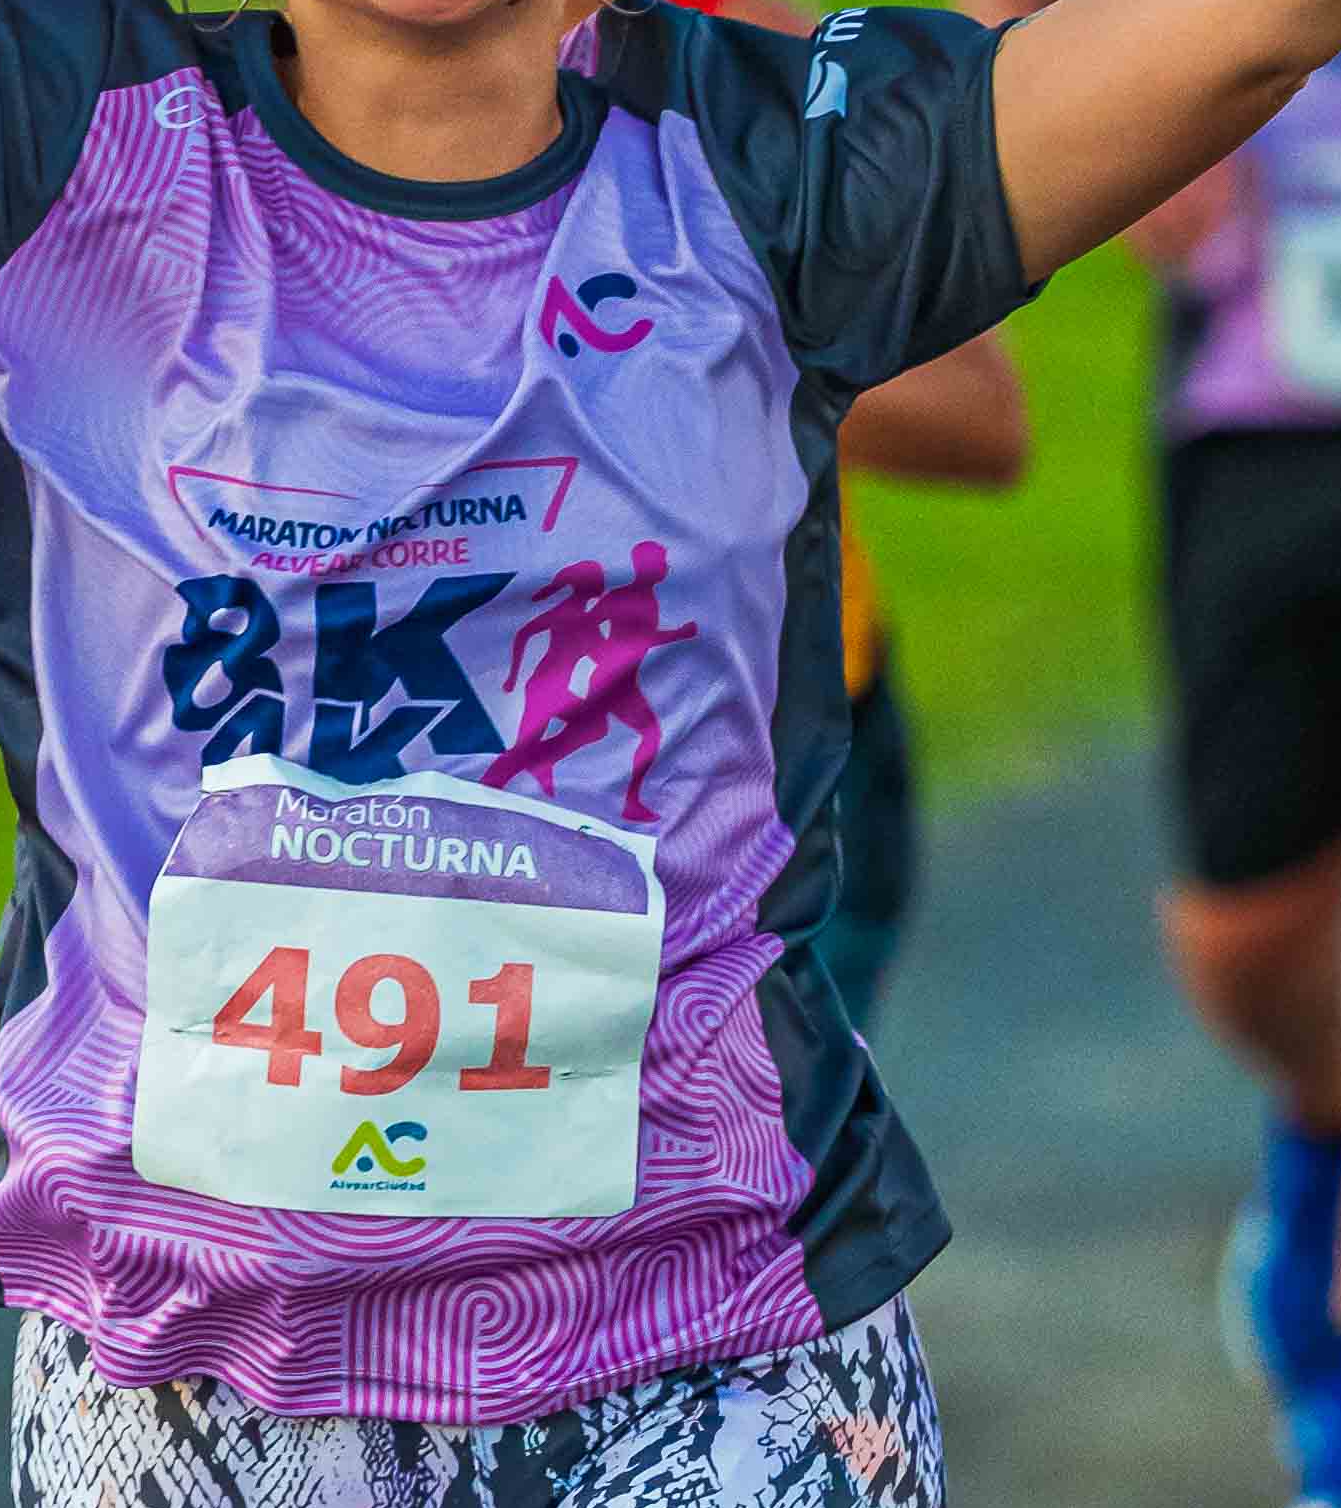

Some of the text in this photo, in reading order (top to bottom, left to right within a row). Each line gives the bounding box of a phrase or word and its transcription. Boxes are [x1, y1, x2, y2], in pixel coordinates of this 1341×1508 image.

[370, 536, 472, 570] CORRE
[162, 572, 517, 755] 8K
[274, 787, 431, 831] Maratón
[271, 824, 538, 879] NOCTURNA
[211, 945, 552, 1097] 491
